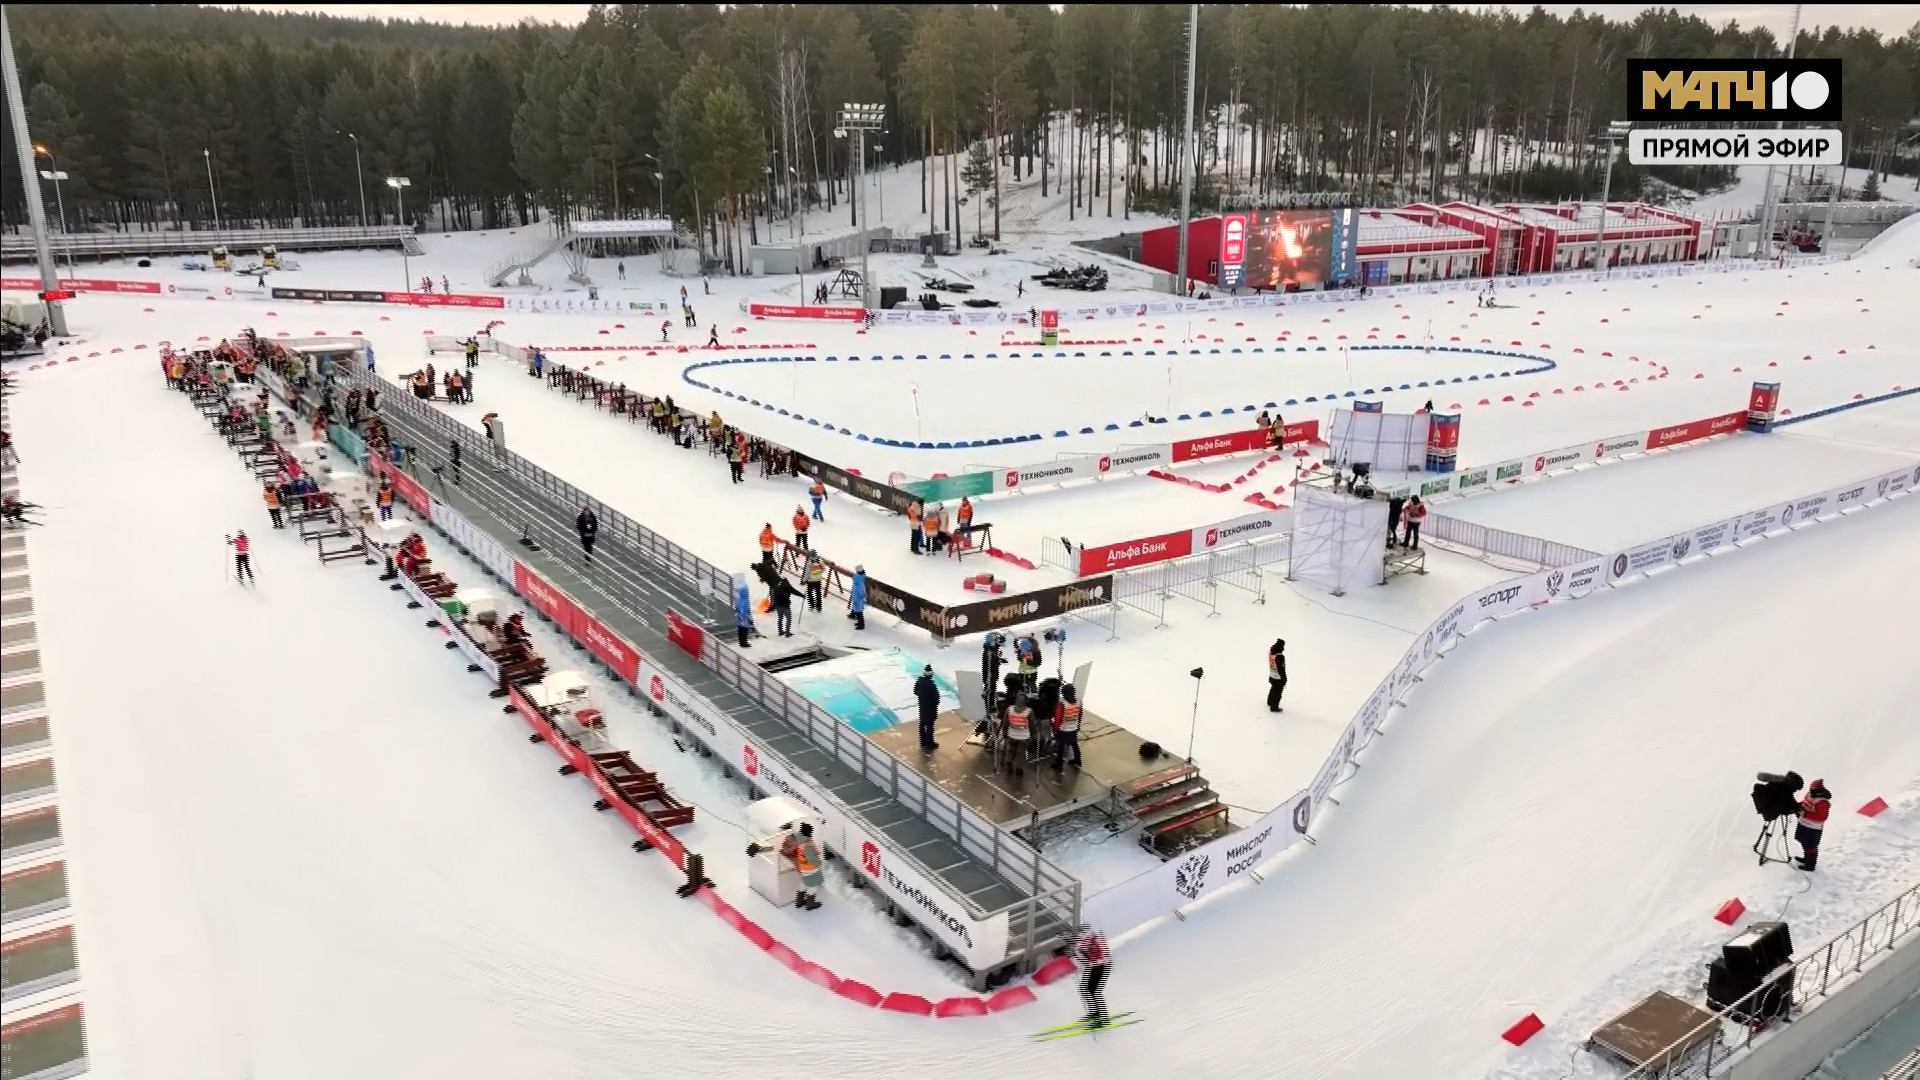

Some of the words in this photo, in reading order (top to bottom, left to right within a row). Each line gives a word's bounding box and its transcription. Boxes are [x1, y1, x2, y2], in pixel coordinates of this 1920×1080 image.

[1214, 439, 1232, 448] Банк
[1112, 452, 1161, 466] ТЕХНОНИКОЛЬ
[1020, 466, 1073, 481] ТЕХНОНИКОЛЬ
[1219, 519, 1272, 539] ТЕХНОНИКОЛЬ
[1106, 545, 1140, 561] Альфа
[1141, 541, 1167, 554] Банк
[665, 689, 717, 737] ТЕХНОНИКОЛЬ
[1226, 826, 1273, 861] МИНСПОРТ
[1226, 848, 1262, 877] РОССИИ
[882, 865, 973, 949] ТЕХНОНИКОЛЬ
